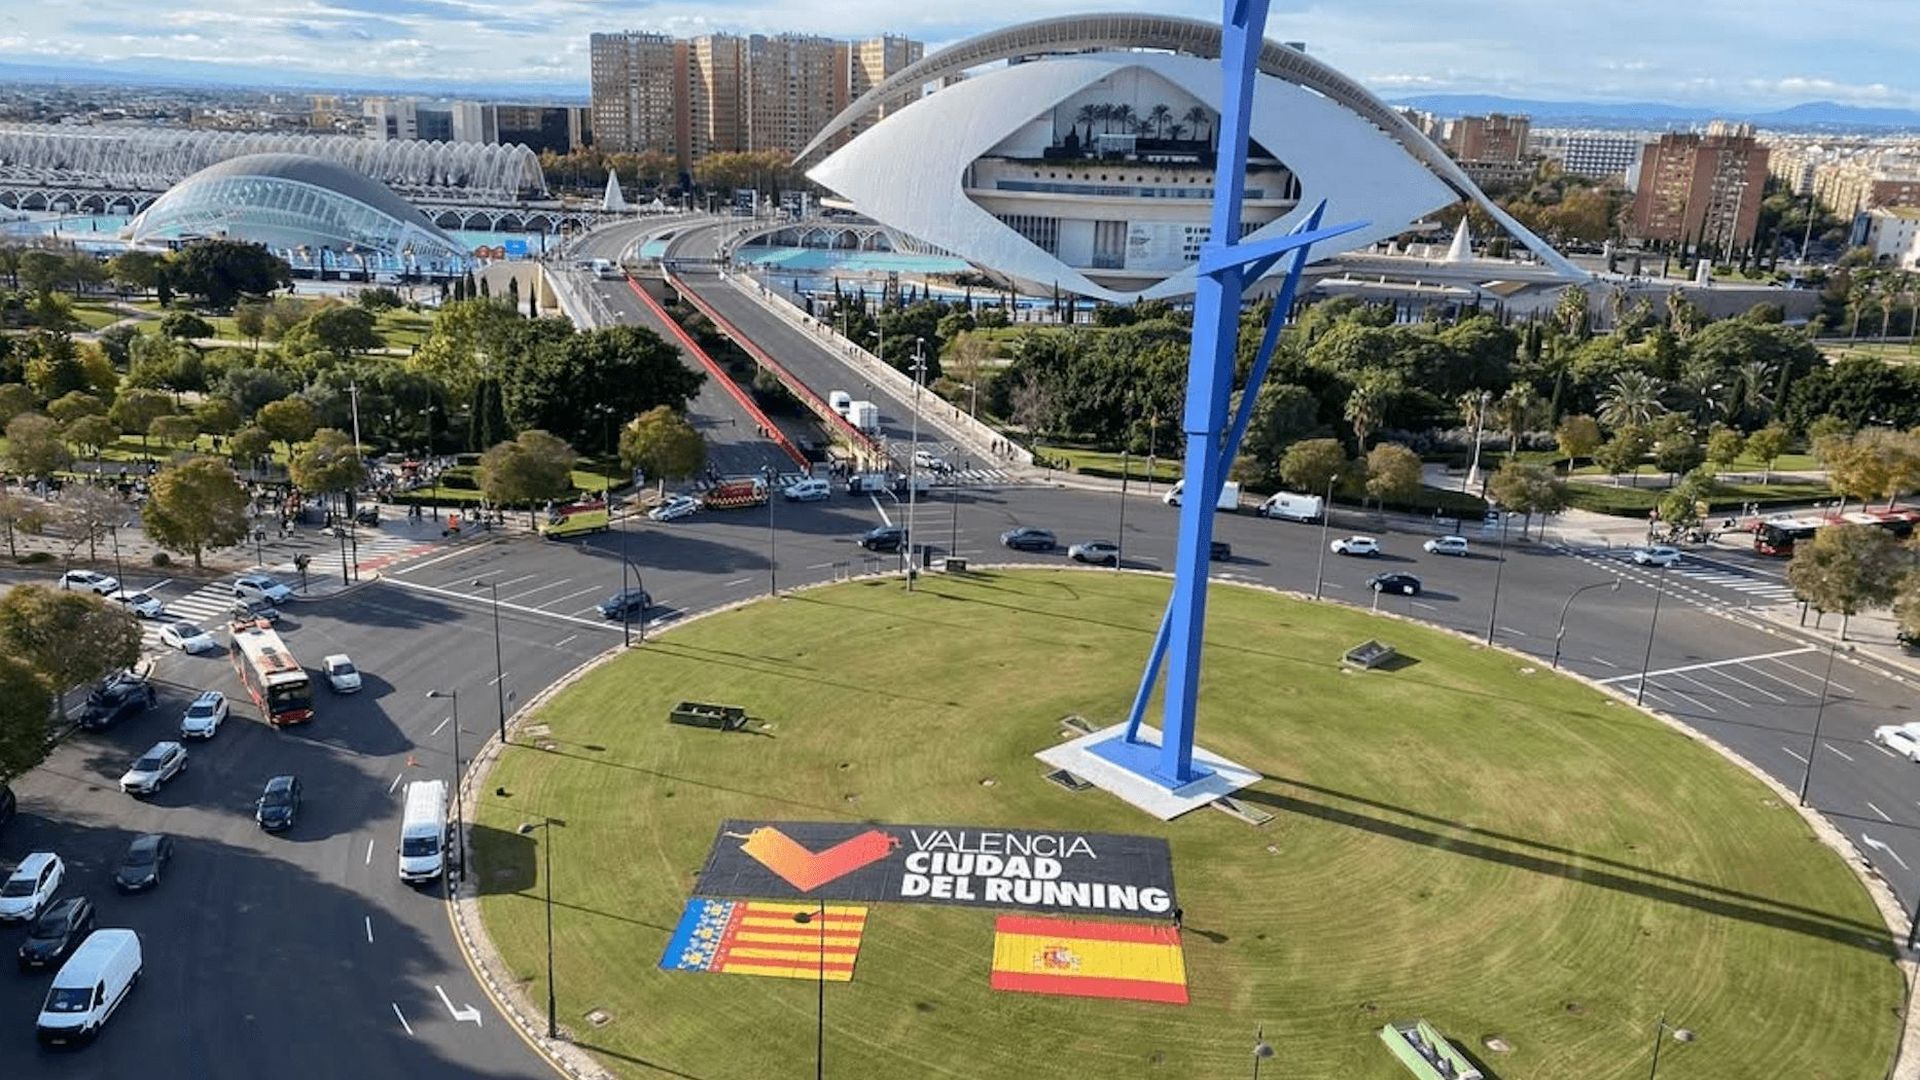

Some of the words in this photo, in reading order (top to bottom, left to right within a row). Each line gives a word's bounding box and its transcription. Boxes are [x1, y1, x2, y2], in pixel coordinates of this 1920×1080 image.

[910, 830, 1097, 859] VALENCIA
[904, 852, 1062, 880] CIUDAD
[901, 874, 976, 900] DEL
[985, 878, 1171, 912] RUNNING
